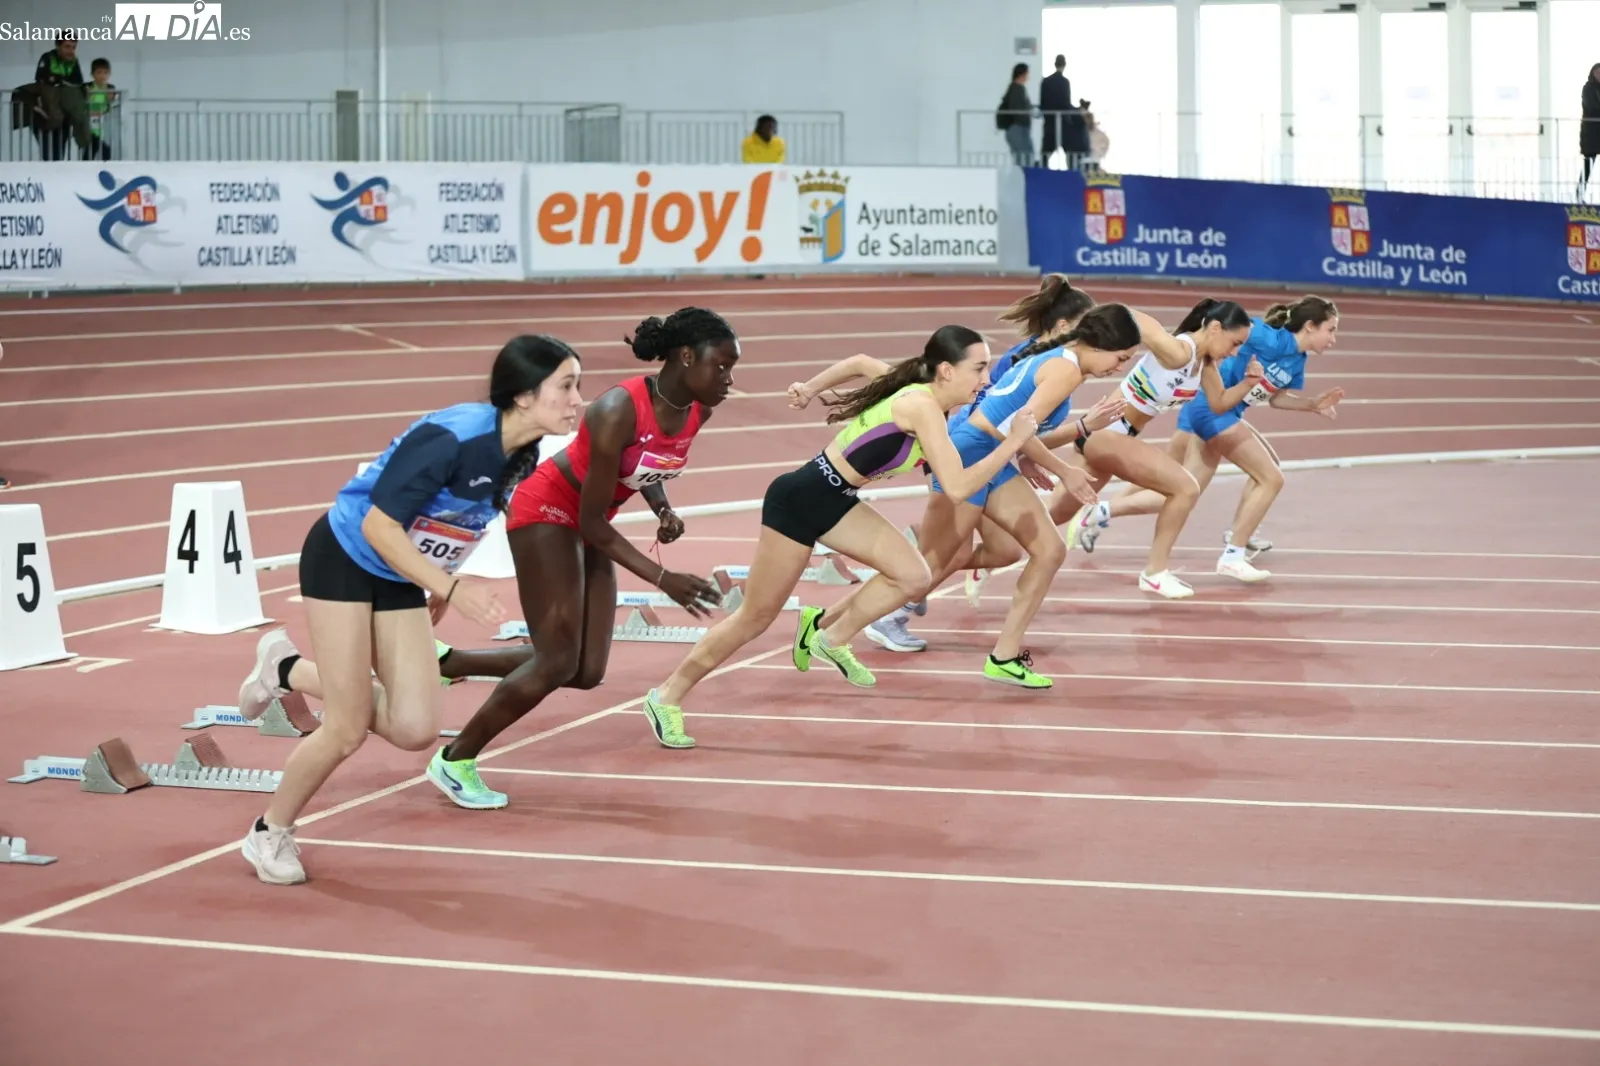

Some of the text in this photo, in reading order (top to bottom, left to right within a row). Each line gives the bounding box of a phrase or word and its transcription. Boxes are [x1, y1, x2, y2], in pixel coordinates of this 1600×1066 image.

[0, 176, 45, 203] RACIÓN
[209, 177, 281, 202] FEDERACIÓN
[438, 178, 505, 202] FEDERACIÓN
[0, 214, 44, 237] ETISMO
[216, 214, 279, 235] ATLETISMO
[443, 214, 501, 233] ATLETISMO
[537, 170, 773, 265] enjoy!
[857, 202, 998, 230] Ayuntamiento
[858, 232, 998, 257] de Salamanca
[1134, 224, 1227, 247] Junta de
[20, 248, 29, 270] Y
[31, 242, 62, 269] LEÓN
[197, 242, 297, 267] CASTILLA Y LEÓN
[428, 240, 518, 264] CASTILLA Y LEÓN
[1075, 246, 1227, 273] Castilla y León
[1378, 239, 1466, 264] Junta de
[1322, 257, 1468, 286] Castilla y León
[815, 455, 842, 487] PRO
[177, 509, 199, 574] 4
[223, 510, 242, 574] 4
[418, 537, 465, 561] 505
[17, 542, 41, 613] 5
